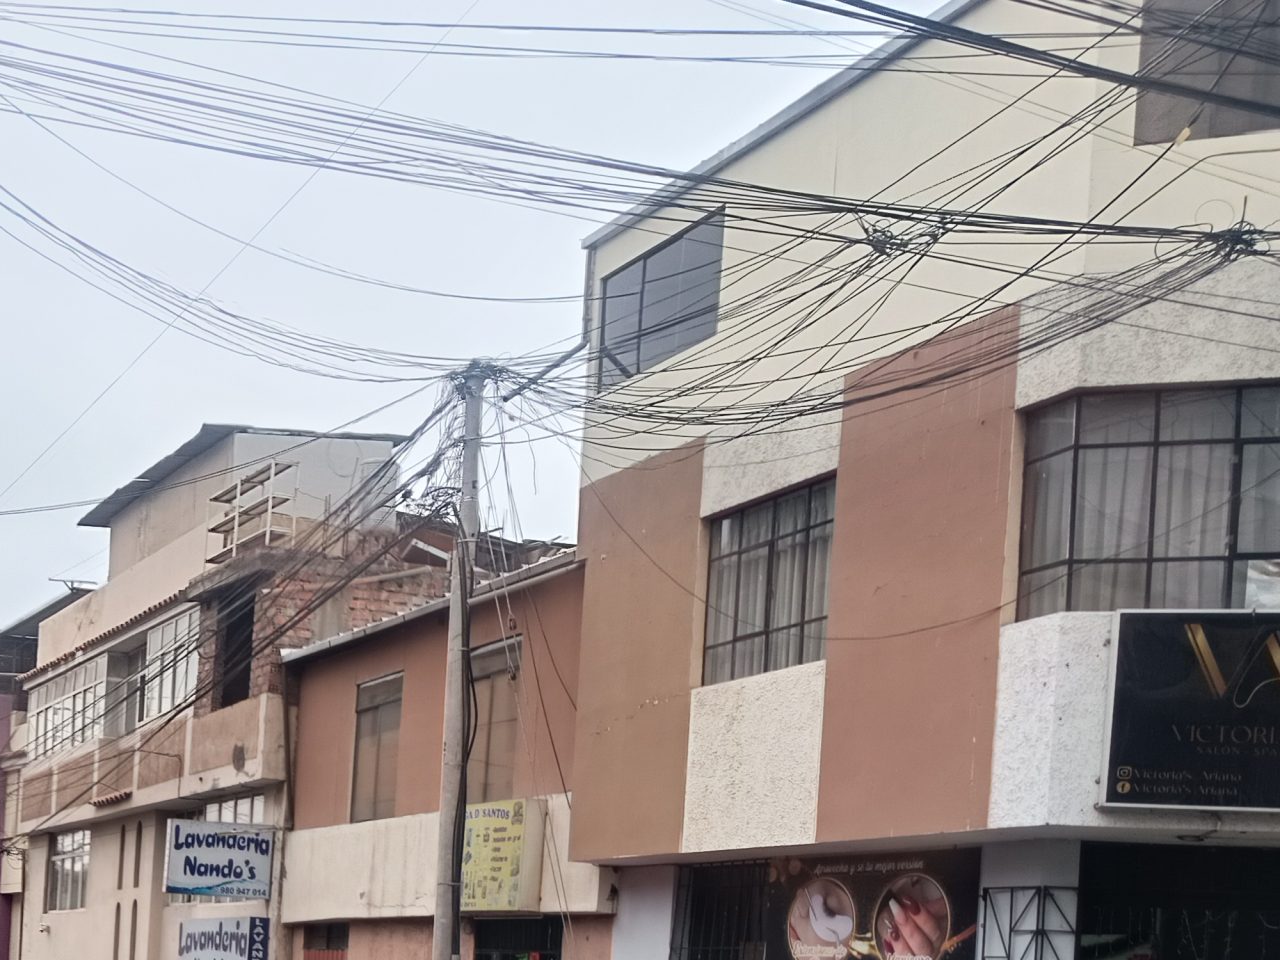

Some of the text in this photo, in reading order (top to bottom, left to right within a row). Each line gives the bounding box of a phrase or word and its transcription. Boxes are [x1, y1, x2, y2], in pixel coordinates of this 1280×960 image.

[1172, 724, 1280, 744] VICTORI
[482, 808, 510, 819] SANTOS
[183, 856, 256, 880] Nando's
[178, 920, 248, 958] Lavanderia
